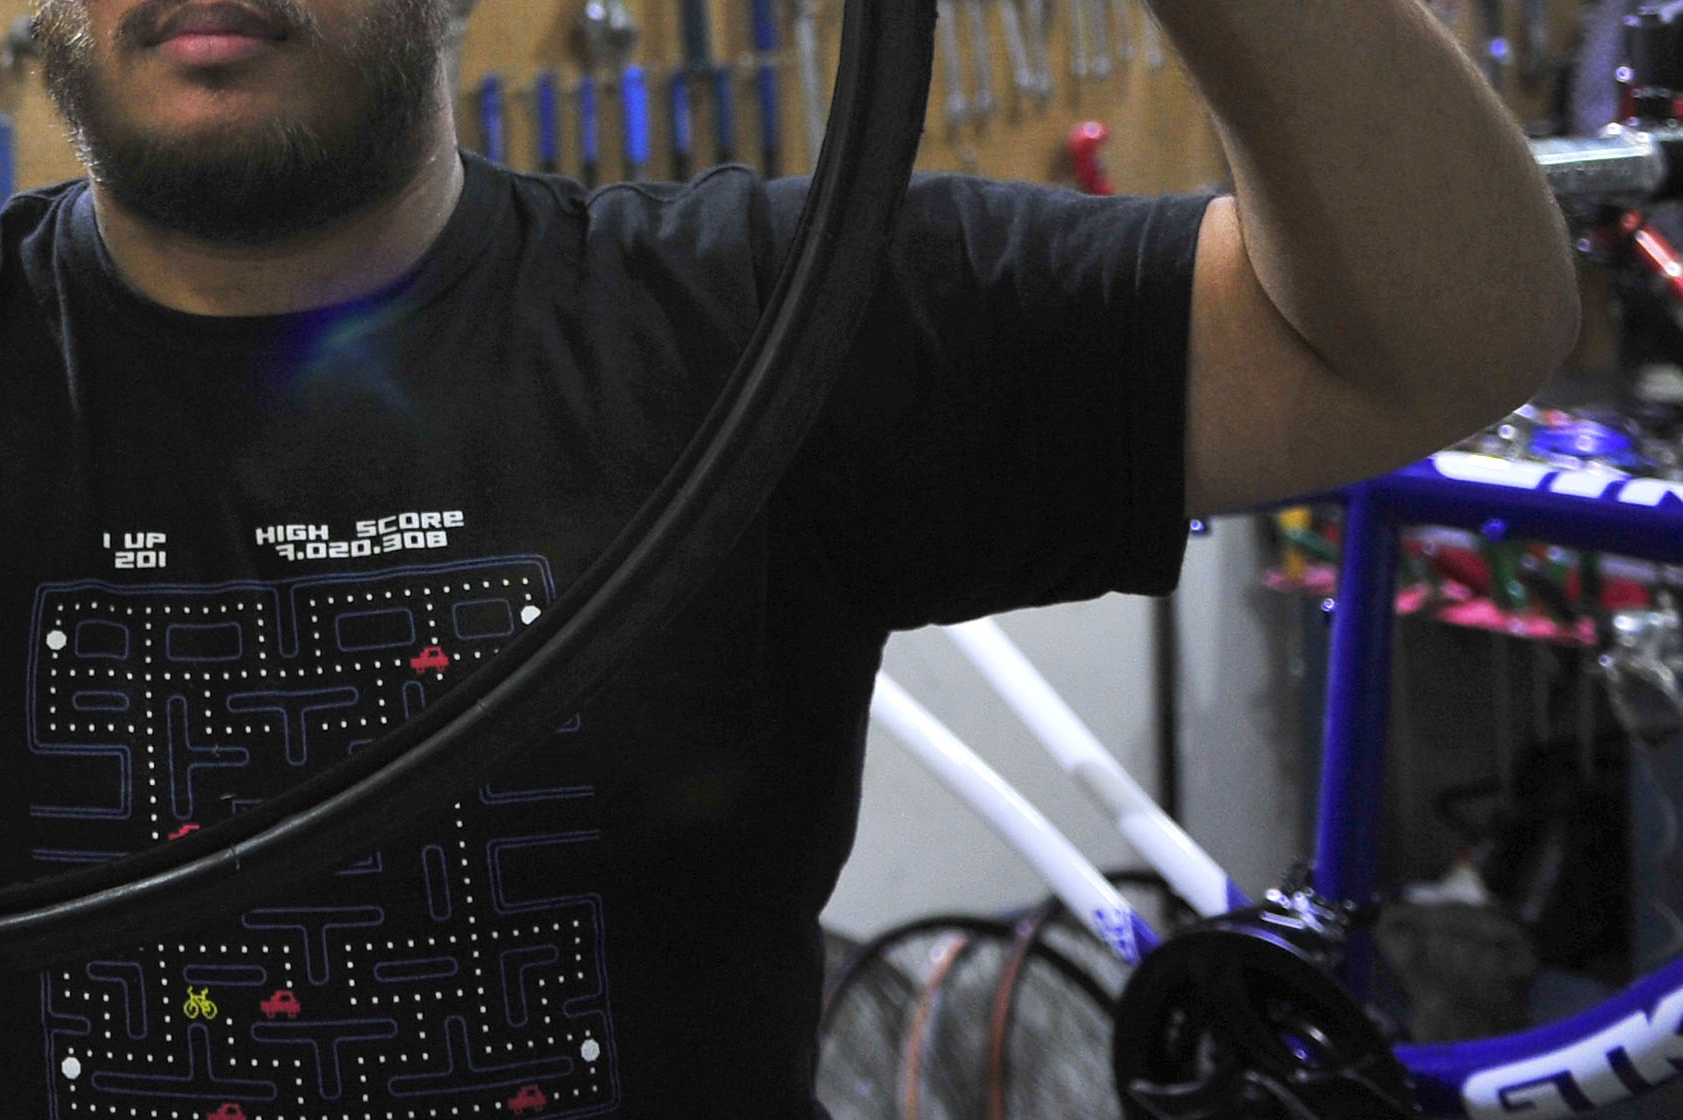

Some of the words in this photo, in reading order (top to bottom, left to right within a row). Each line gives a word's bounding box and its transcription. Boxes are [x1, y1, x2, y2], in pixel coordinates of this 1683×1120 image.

[255, 524, 330, 546] HIGH
[355, 510, 465, 538] SCORE
[124, 532, 167, 549] UP
[114, 550, 167, 569] 201
